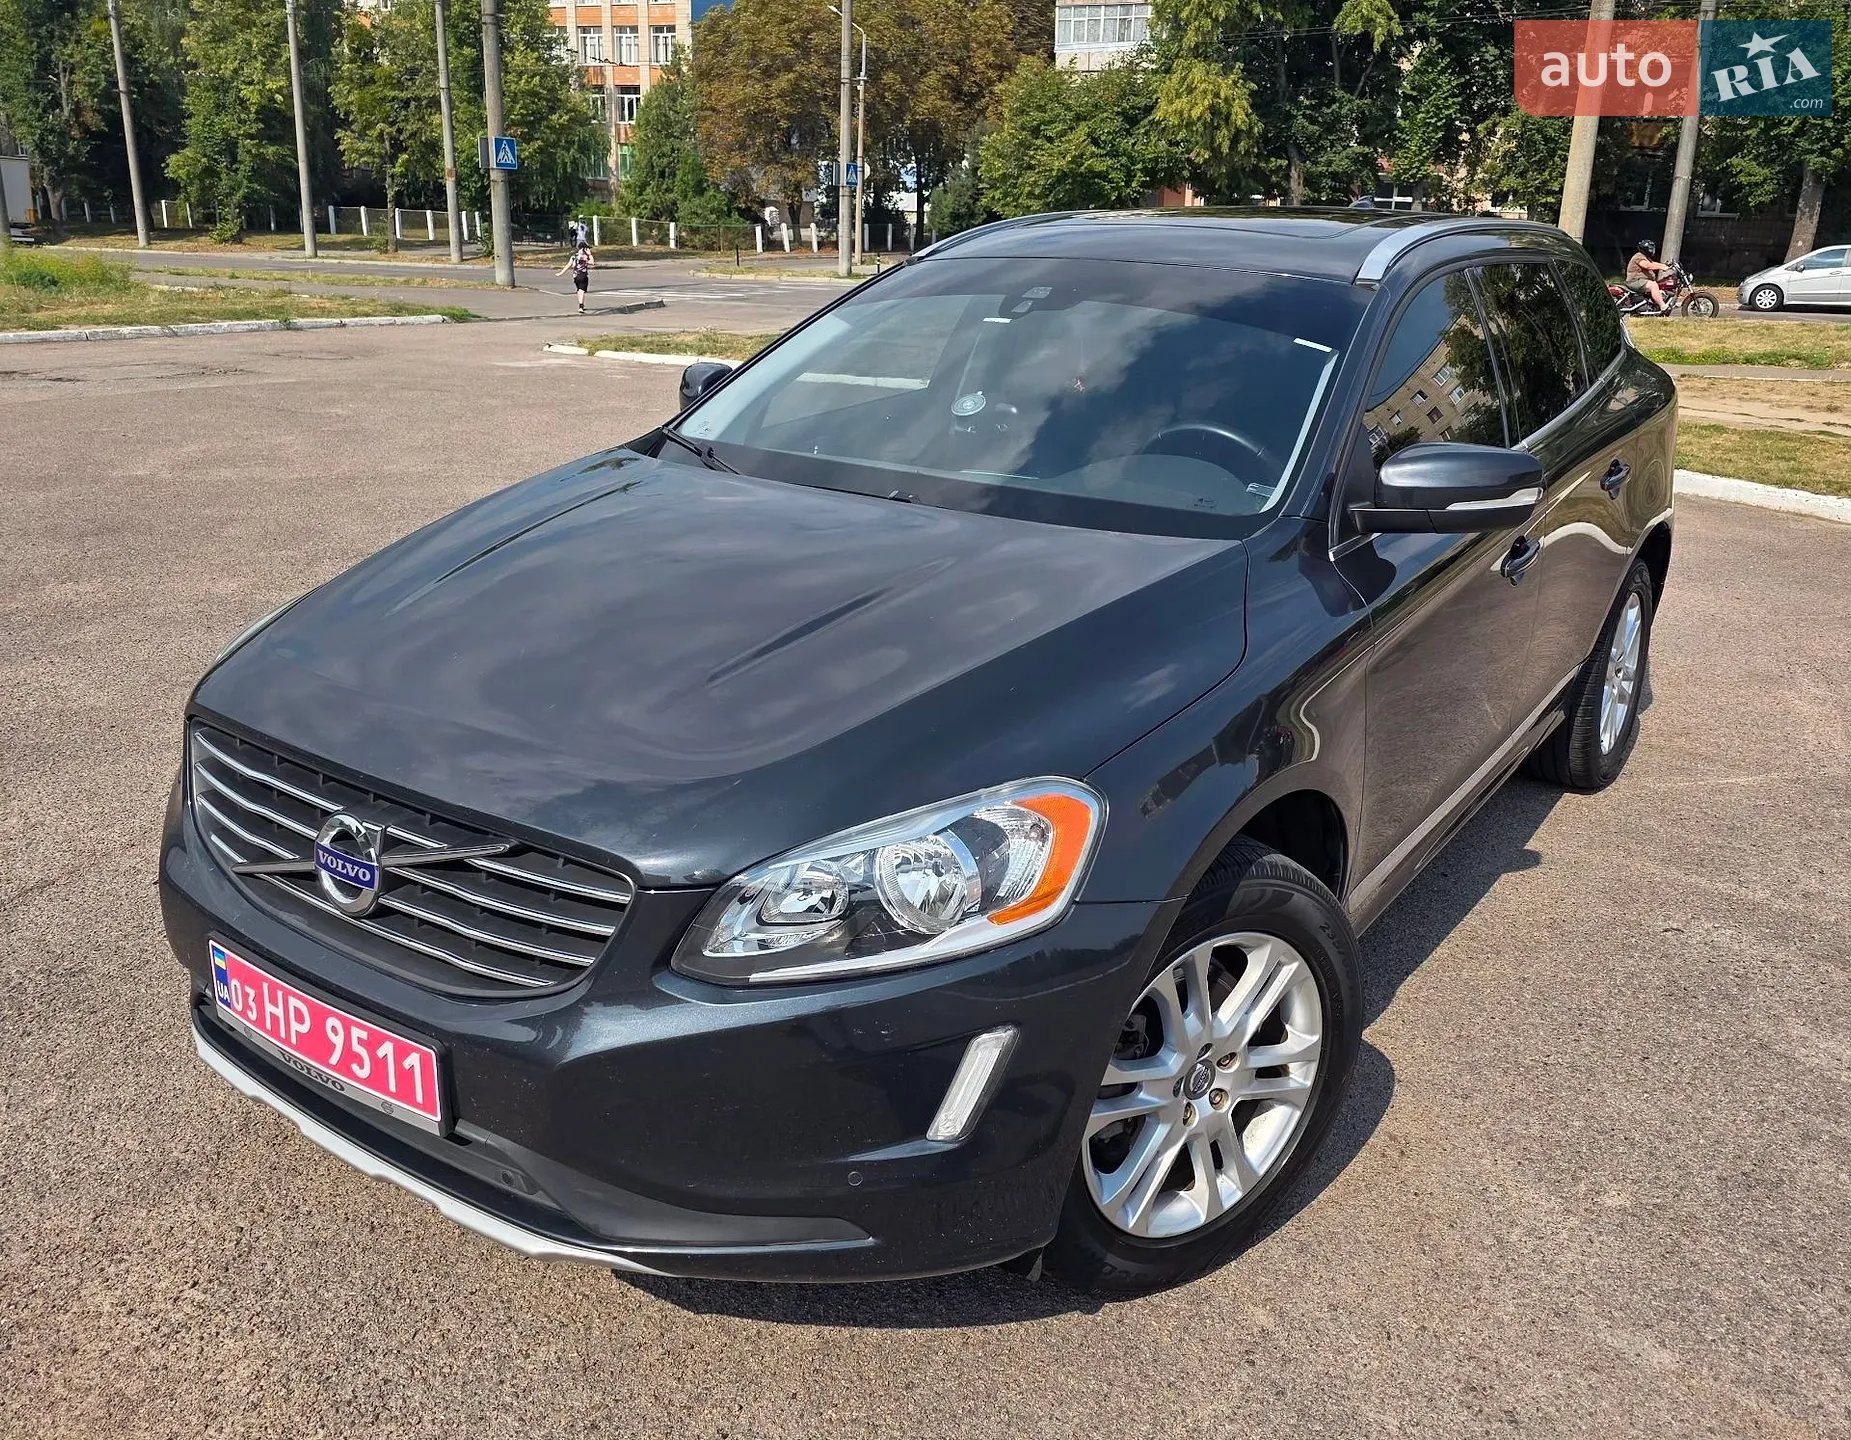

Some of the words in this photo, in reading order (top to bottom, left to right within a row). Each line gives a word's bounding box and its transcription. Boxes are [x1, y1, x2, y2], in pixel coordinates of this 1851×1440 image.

[317, 848, 371, 882] VOLVO
[217, 980, 231, 1003] UA
[231, 978, 258, 1021] 03
[262, 981, 312, 1046] HP
[325, 1016, 424, 1105] 9511
[278, 1048, 345, 1092] VOLVO
